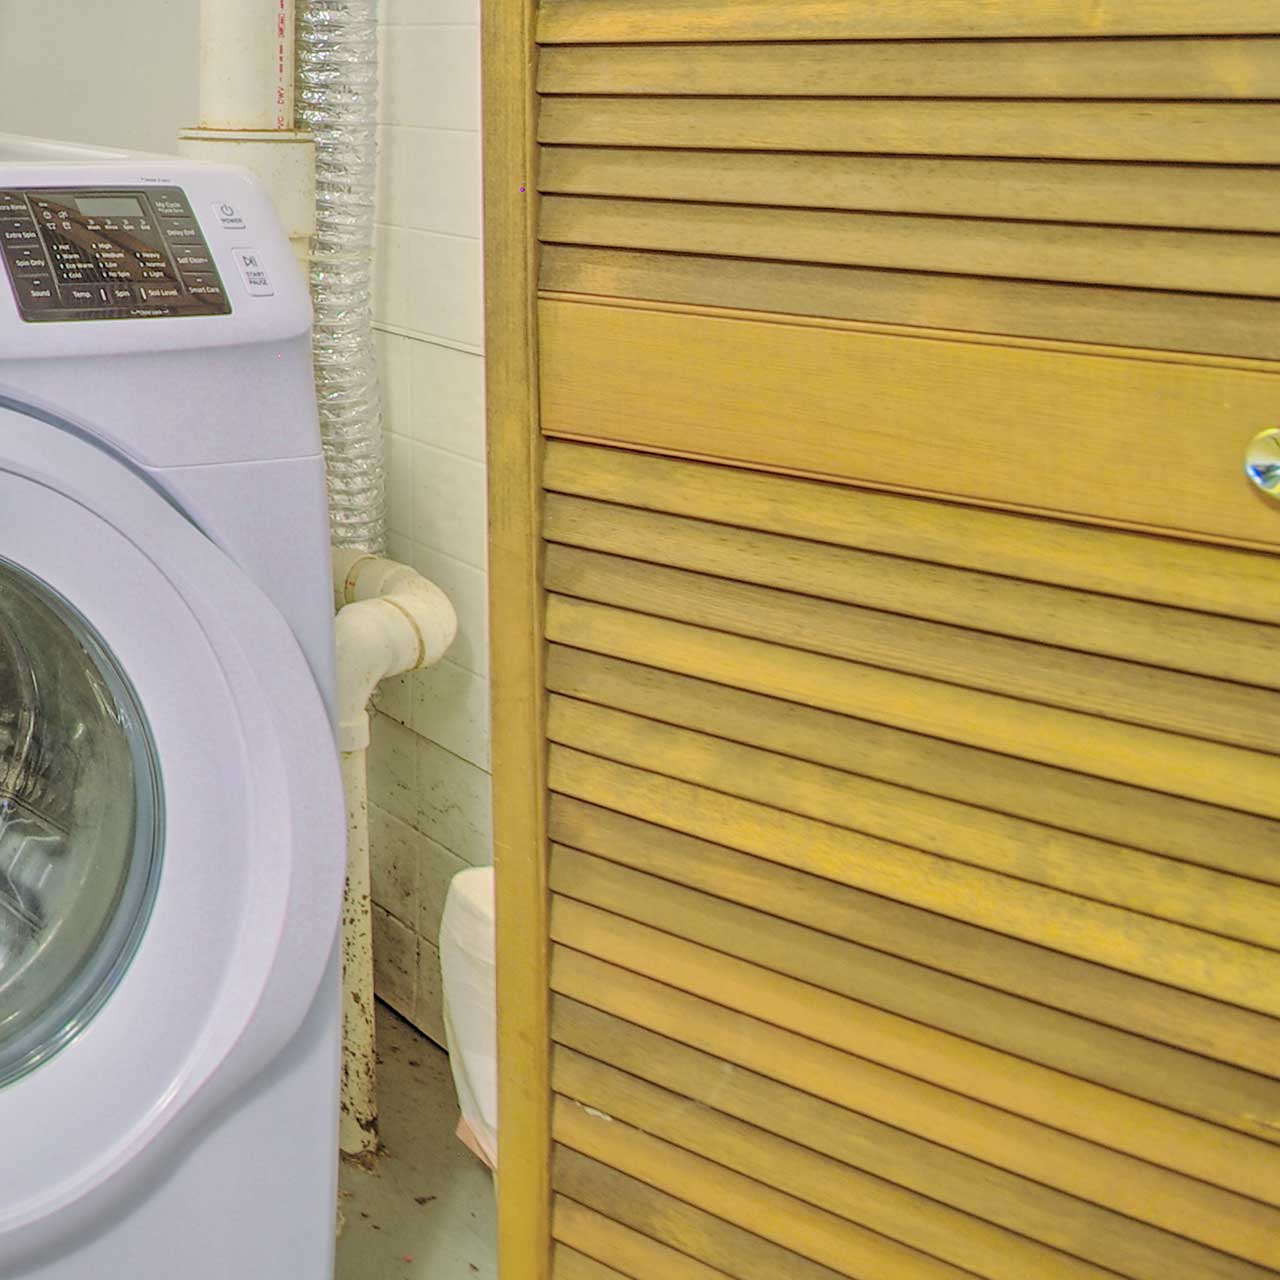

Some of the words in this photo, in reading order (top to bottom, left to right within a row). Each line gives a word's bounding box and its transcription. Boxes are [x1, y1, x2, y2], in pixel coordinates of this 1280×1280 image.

[166, 229, 184, 237] Delay
[30, 289, 51, 297] Sound
[188, 286, 205, 294] Smart
